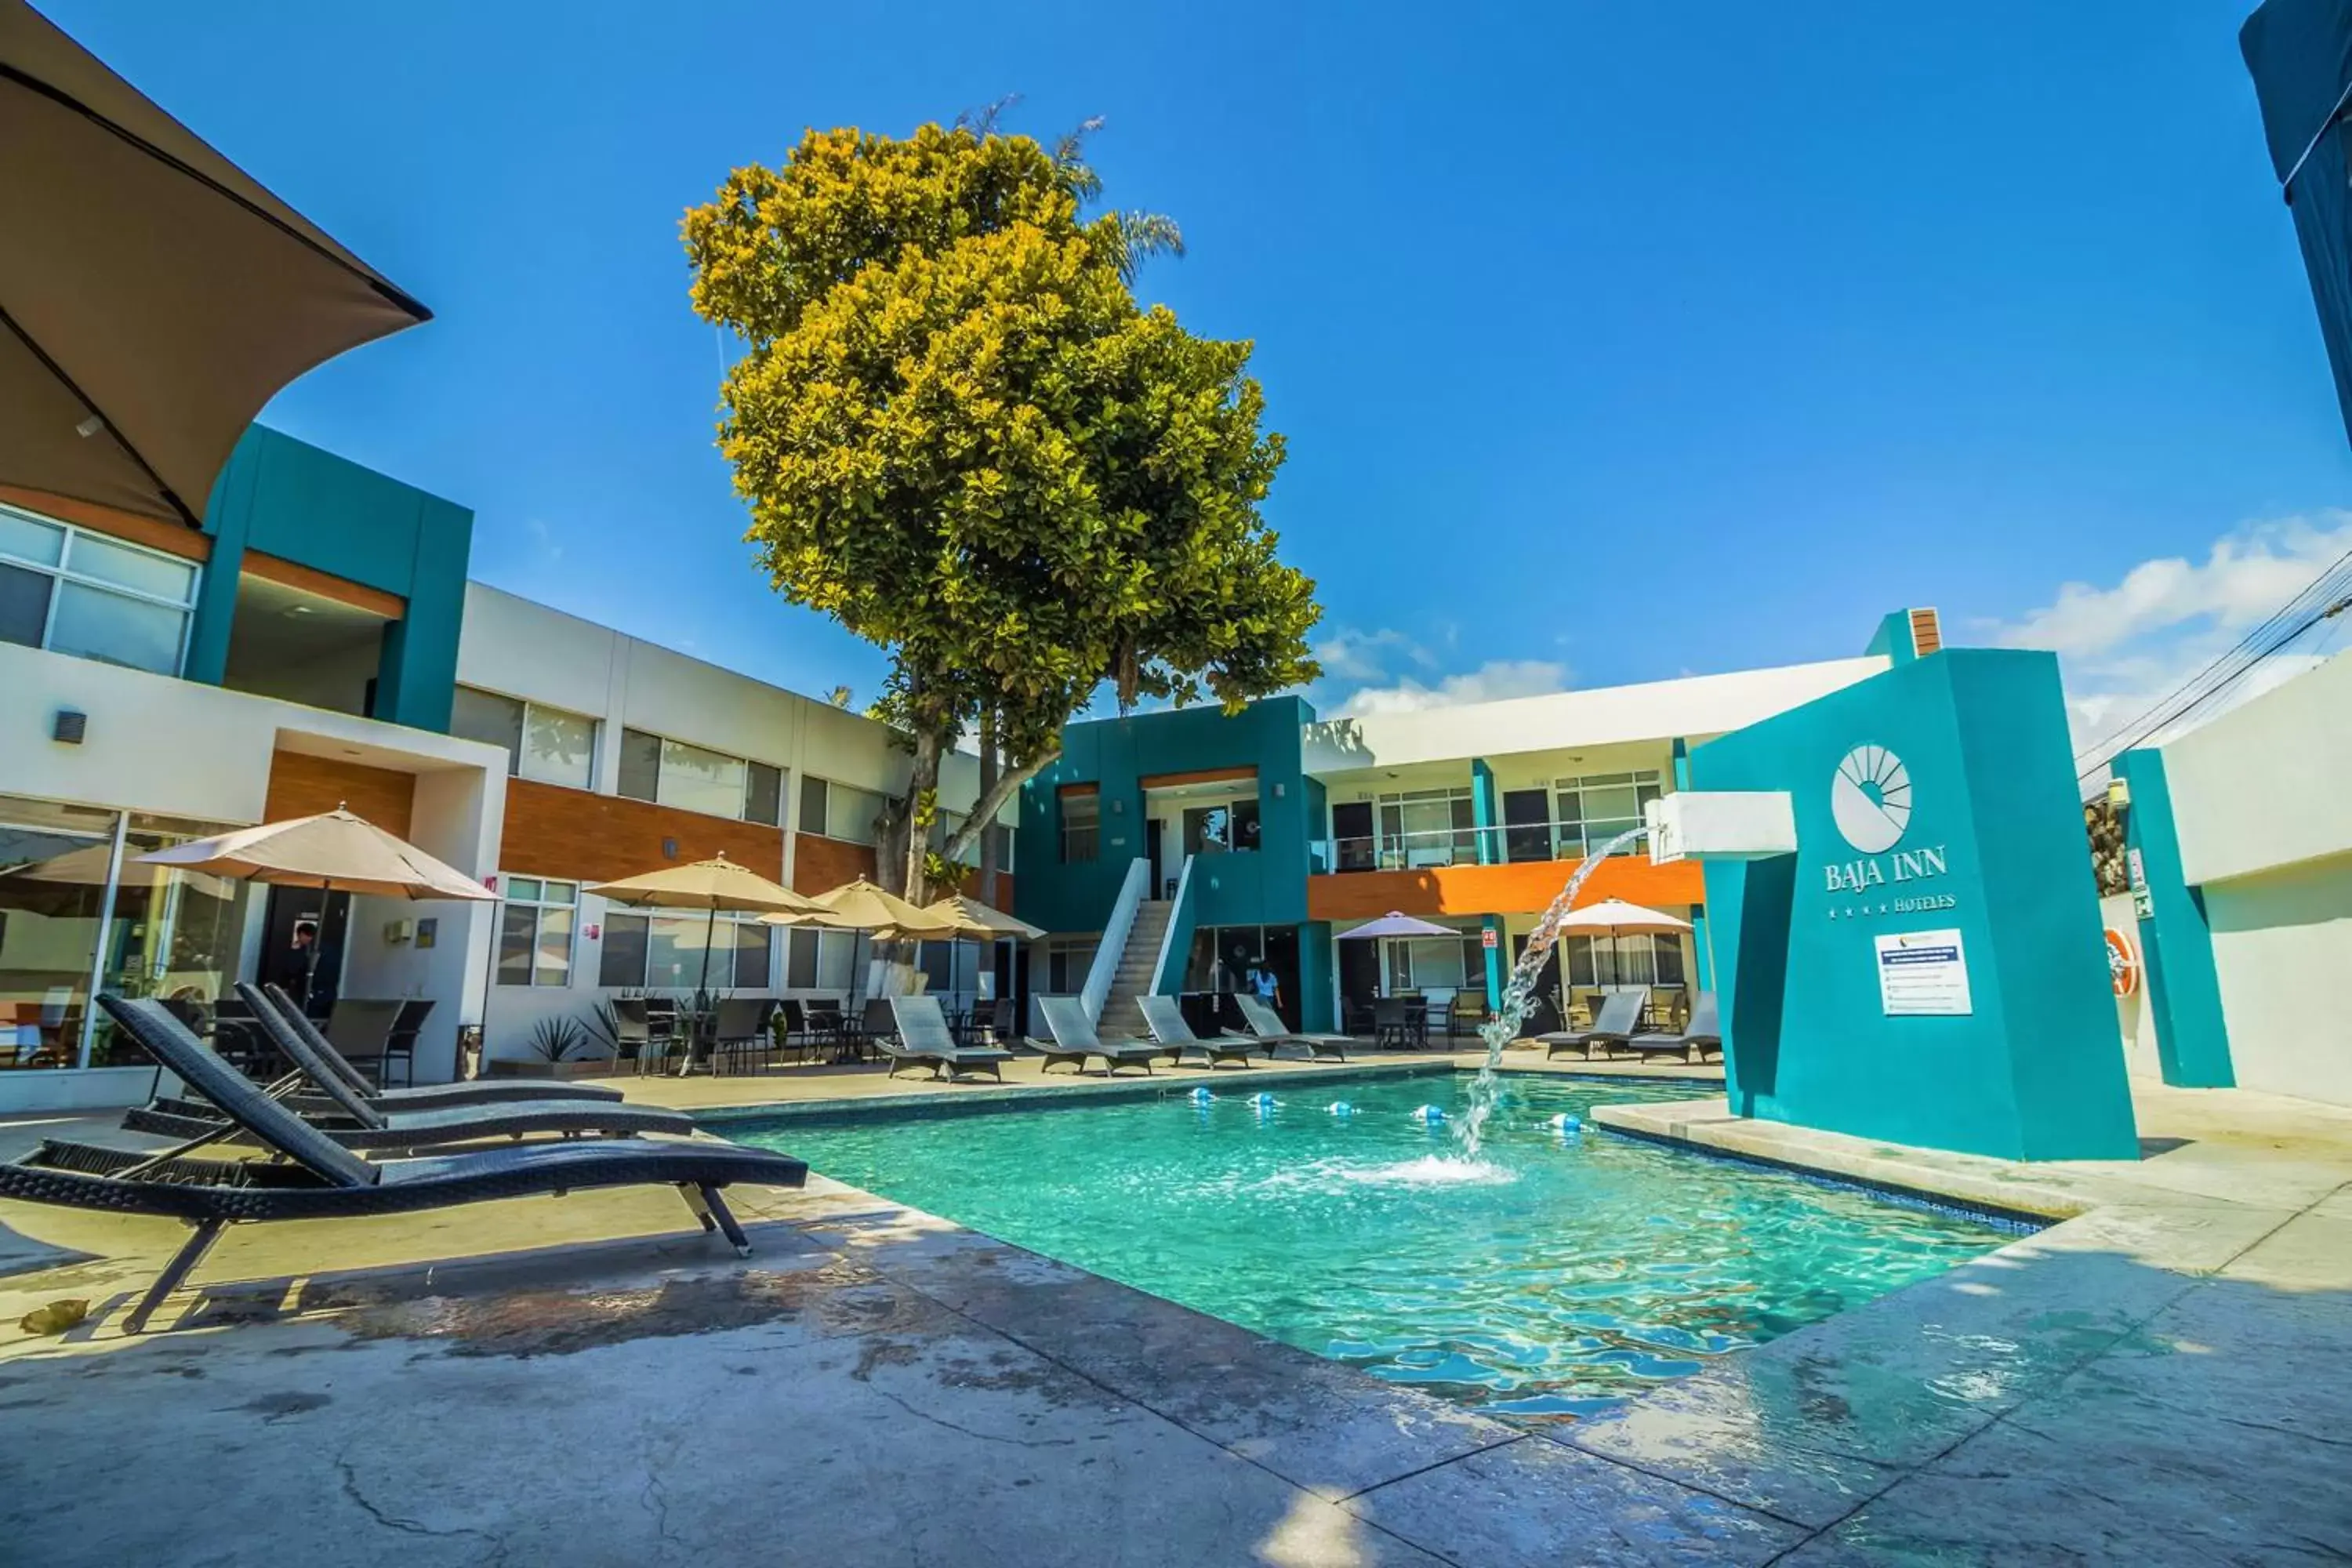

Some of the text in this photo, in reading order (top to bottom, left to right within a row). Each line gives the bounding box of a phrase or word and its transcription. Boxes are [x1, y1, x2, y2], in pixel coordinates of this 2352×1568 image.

[1824, 845, 1947, 893] BAJA INN
[1895, 894, 1957, 913] HOTELES
